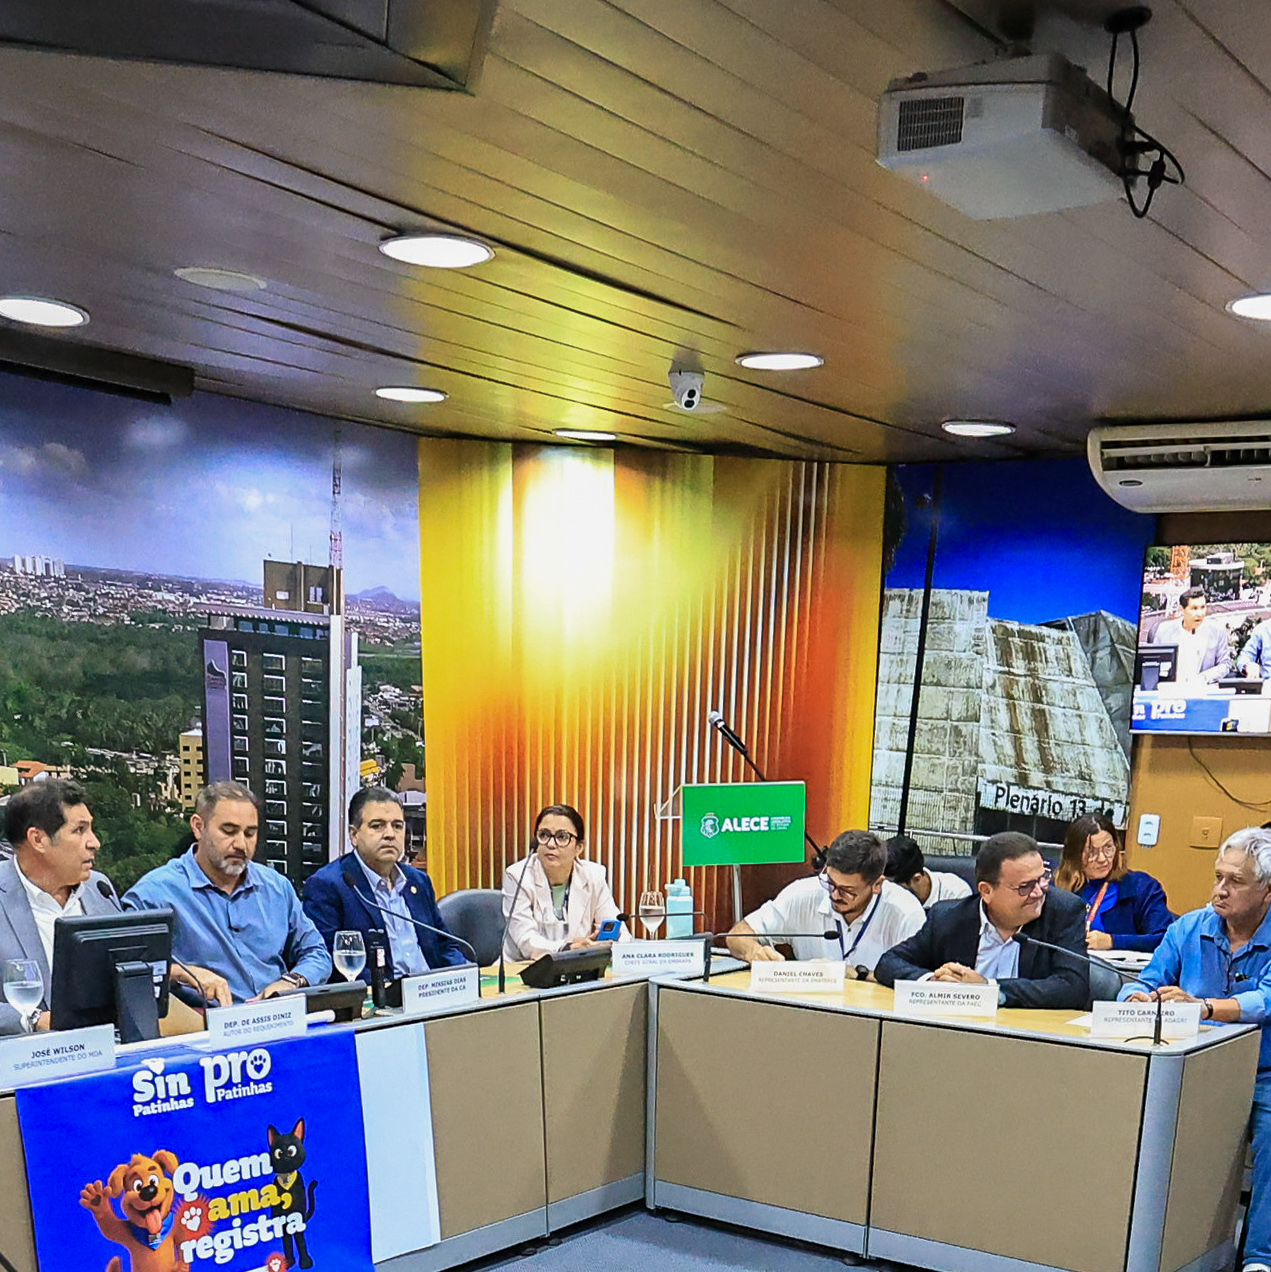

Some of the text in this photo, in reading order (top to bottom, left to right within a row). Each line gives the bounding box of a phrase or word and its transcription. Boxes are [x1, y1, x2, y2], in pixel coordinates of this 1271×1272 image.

[994, 782, 1062, 815] Plenário
[721, 816, 769, 832] ALECE
[224, 1012, 292, 1029] DEP. DE ASSIS DINIZ
[13, 1055, 75, 1071] SUPERINTENDENTE
[77, 1052, 87, 1060] DO
[31, 1043, 85, 1059] JOSÉ WILSON
[132, 1058, 191, 1102] Sin
[199, 1048, 271, 1103] pro
[216, 1082, 273, 1102] Patinhas
[132, 1097, 194, 1117] Patinhas
[173, 1152, 273, 1202] Quem
[208, 1184, 292, 1221] ama,
[180, 1212, 306, 1264] registra
